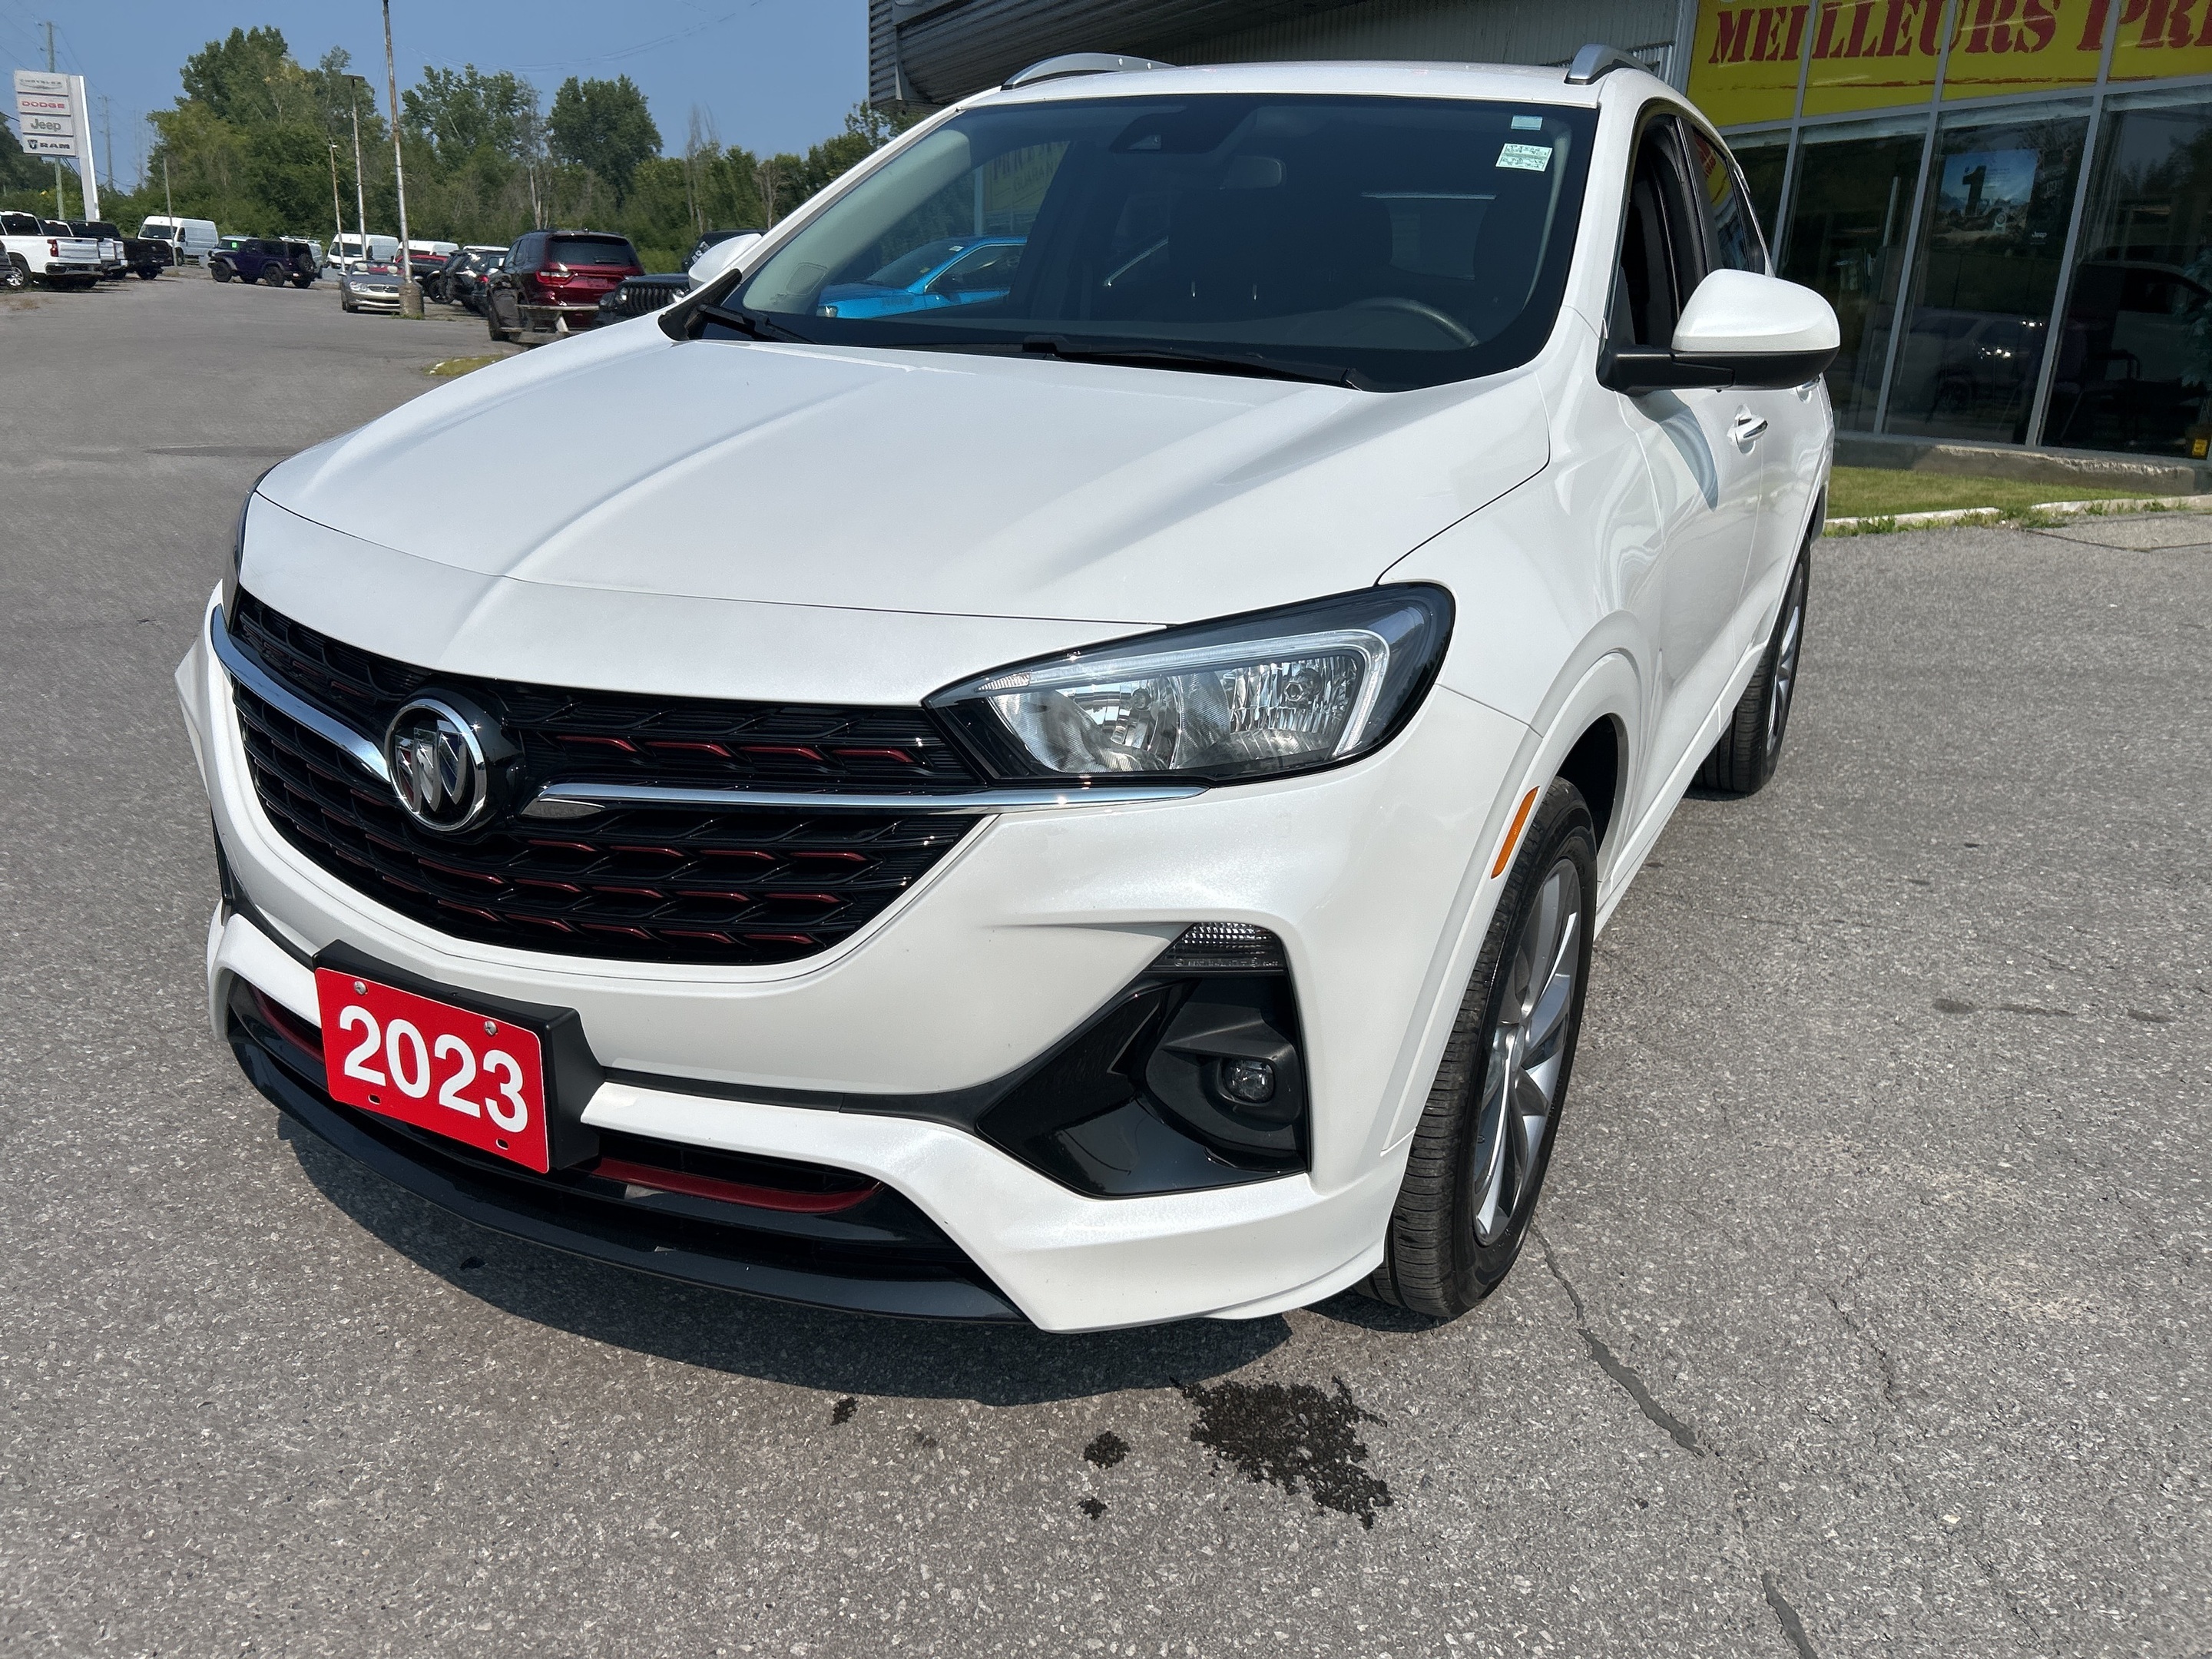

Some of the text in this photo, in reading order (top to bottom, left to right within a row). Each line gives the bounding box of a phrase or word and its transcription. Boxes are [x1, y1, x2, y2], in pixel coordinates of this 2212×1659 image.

[1708, 0, 2061, 65] MEILLEURS
[22, 101, 65, 109] DODGE
[30, 118, 61, 132] Jeep
[339, 1005, 529, 1134] 2023
